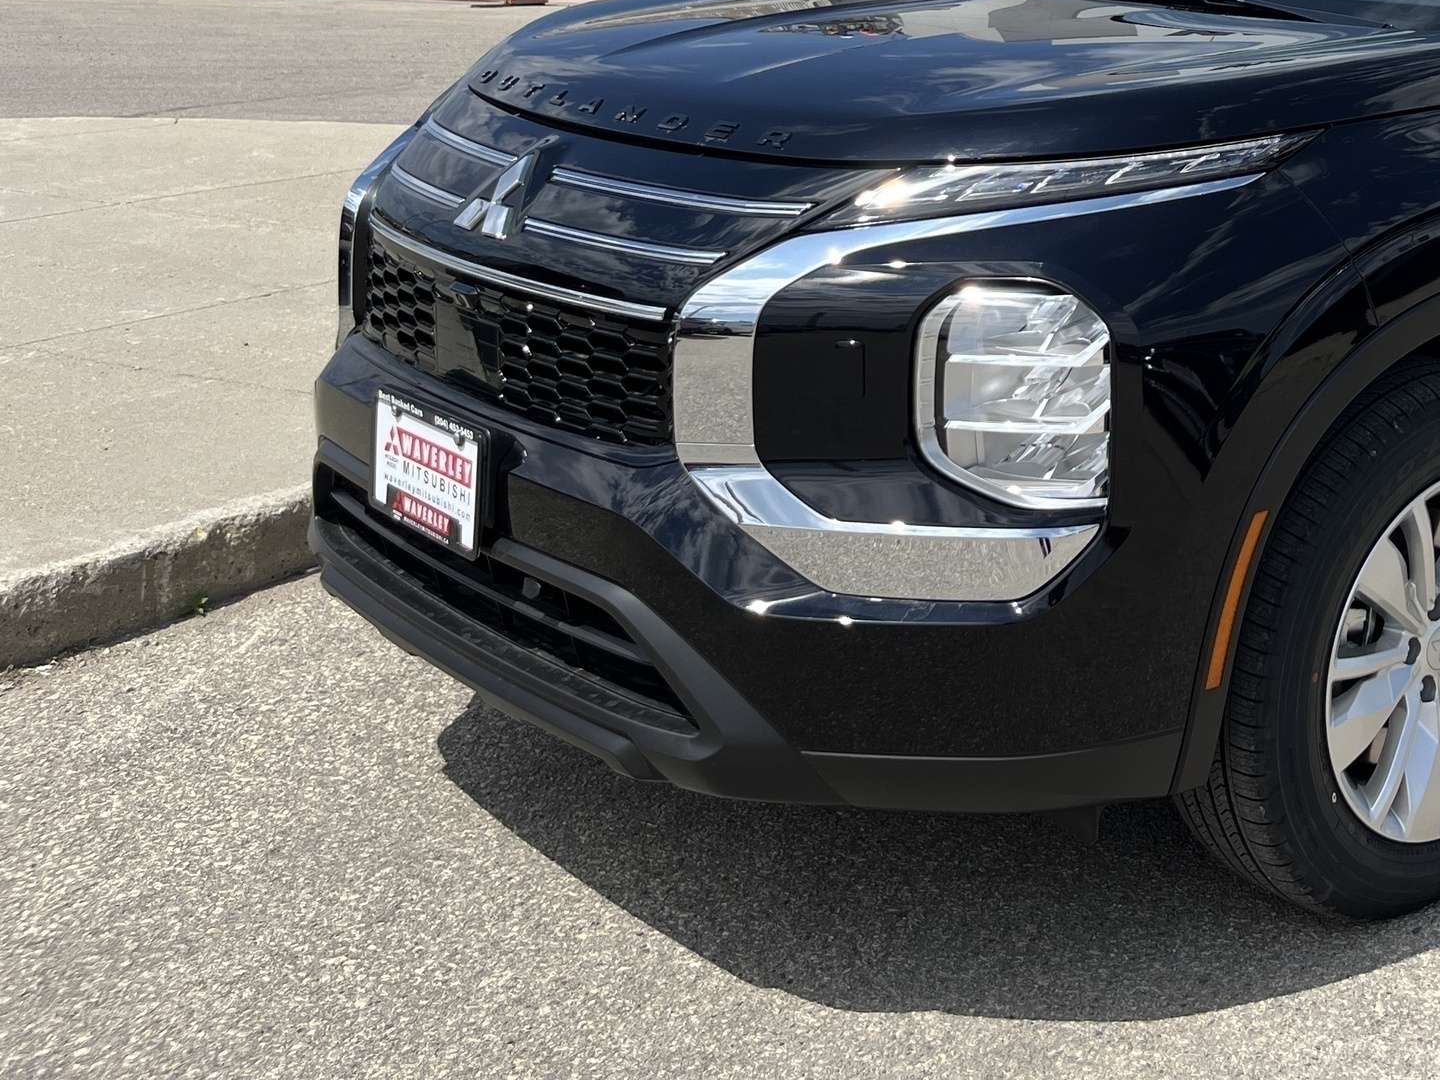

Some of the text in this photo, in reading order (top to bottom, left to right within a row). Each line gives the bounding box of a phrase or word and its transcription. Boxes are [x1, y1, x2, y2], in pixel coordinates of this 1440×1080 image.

[479, 70, 793, 150] OUTLANDER
[402, 431, 473, 486] WAVERLEY
[402, 460, 471, 505] MITSUBISHI
[403, 495, 450, 533] WAVERLEY
